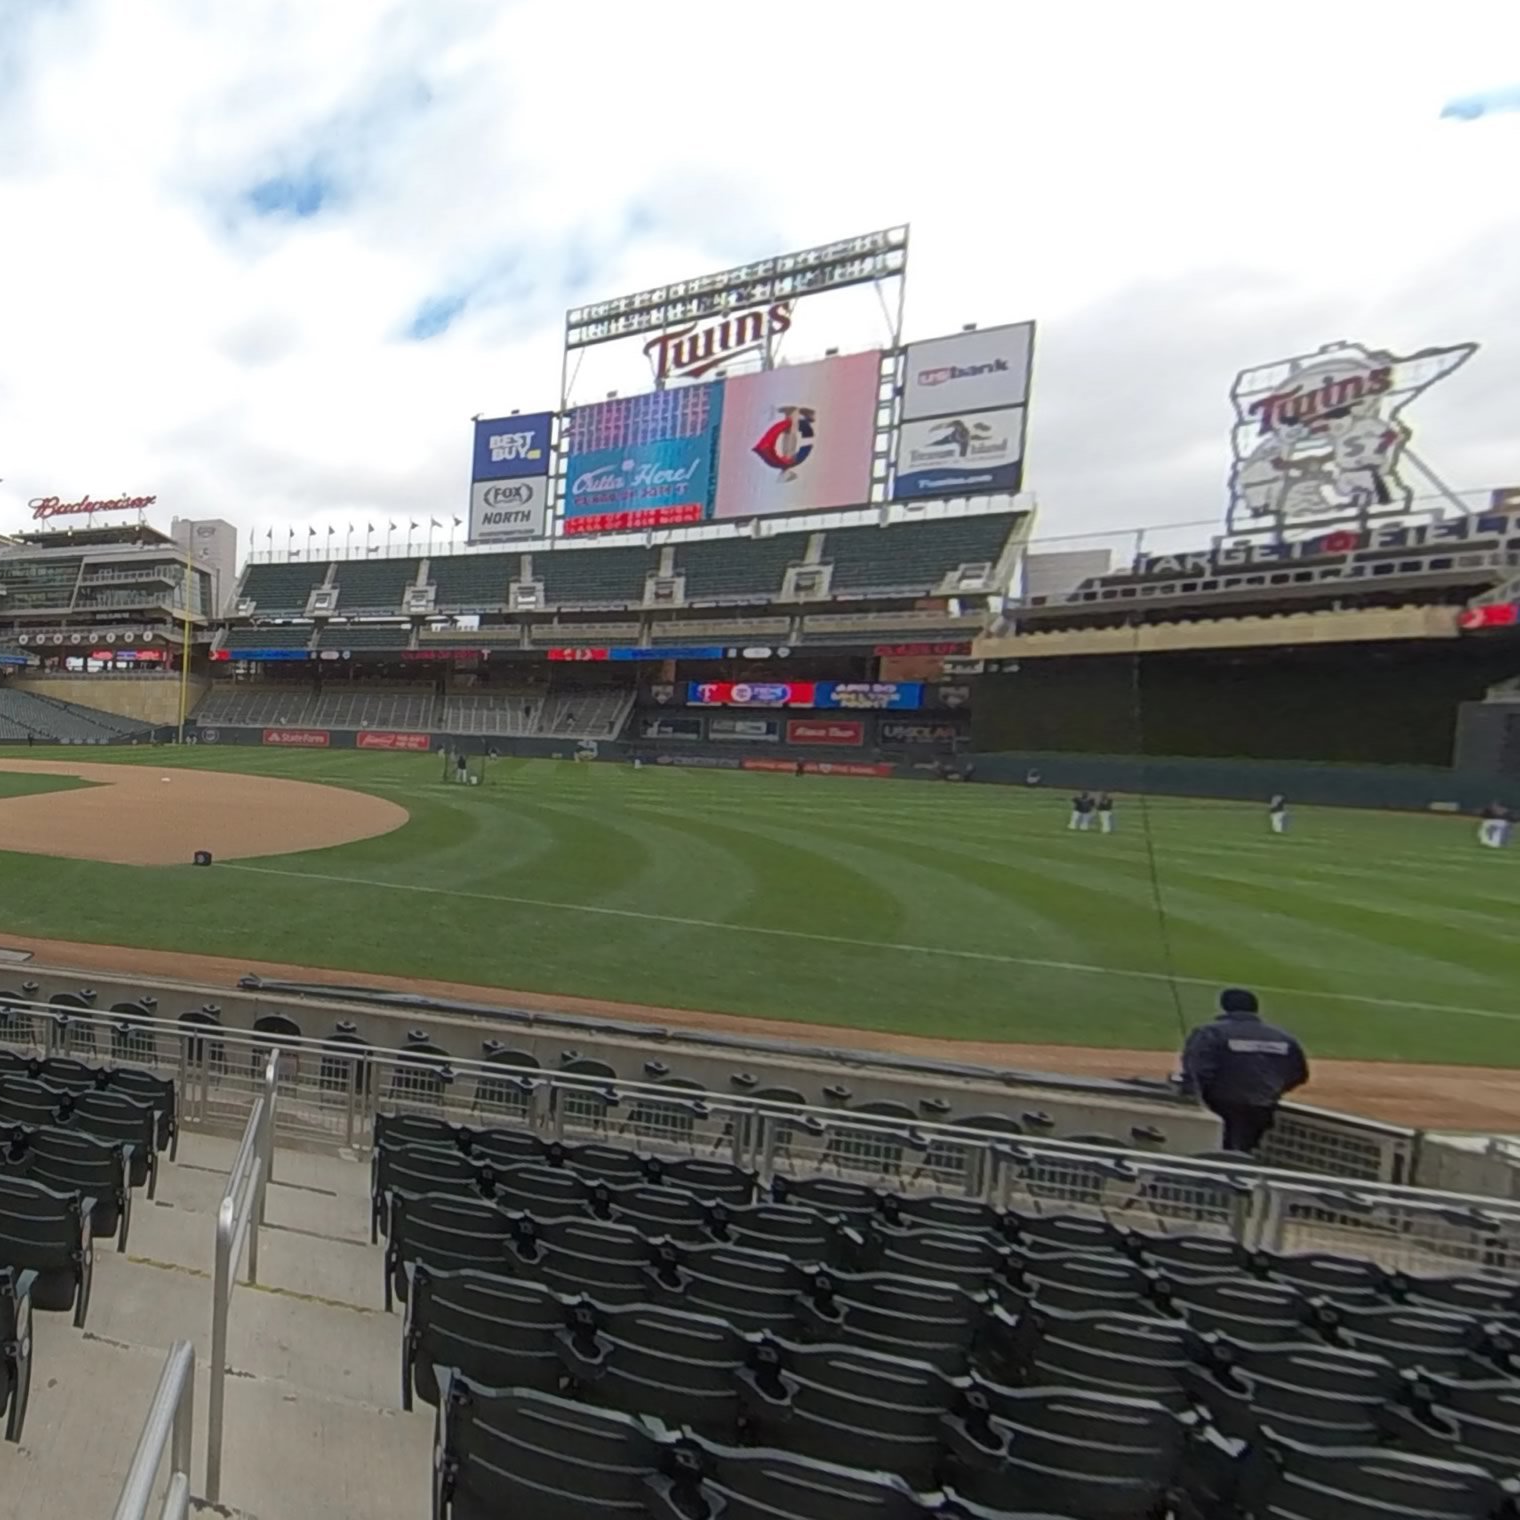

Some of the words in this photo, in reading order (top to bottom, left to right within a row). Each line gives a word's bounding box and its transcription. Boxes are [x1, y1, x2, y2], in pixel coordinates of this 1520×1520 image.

[643, 302, 791, 378] Twins
[1249, 366, 1393, 436] Twins
[490, 431, 535, 449] BEST
[491, 446, 528, 462] BUY
[572, 464, 625, 495] Outta
[630, 458, 700, 485] Here!
[494, 486, 522, 500] FOX
[28, 494, 156, 519] Budweiser
[482, 510, 531, 525] NORTH
[1135, 541, 1304, 576] TARGET
